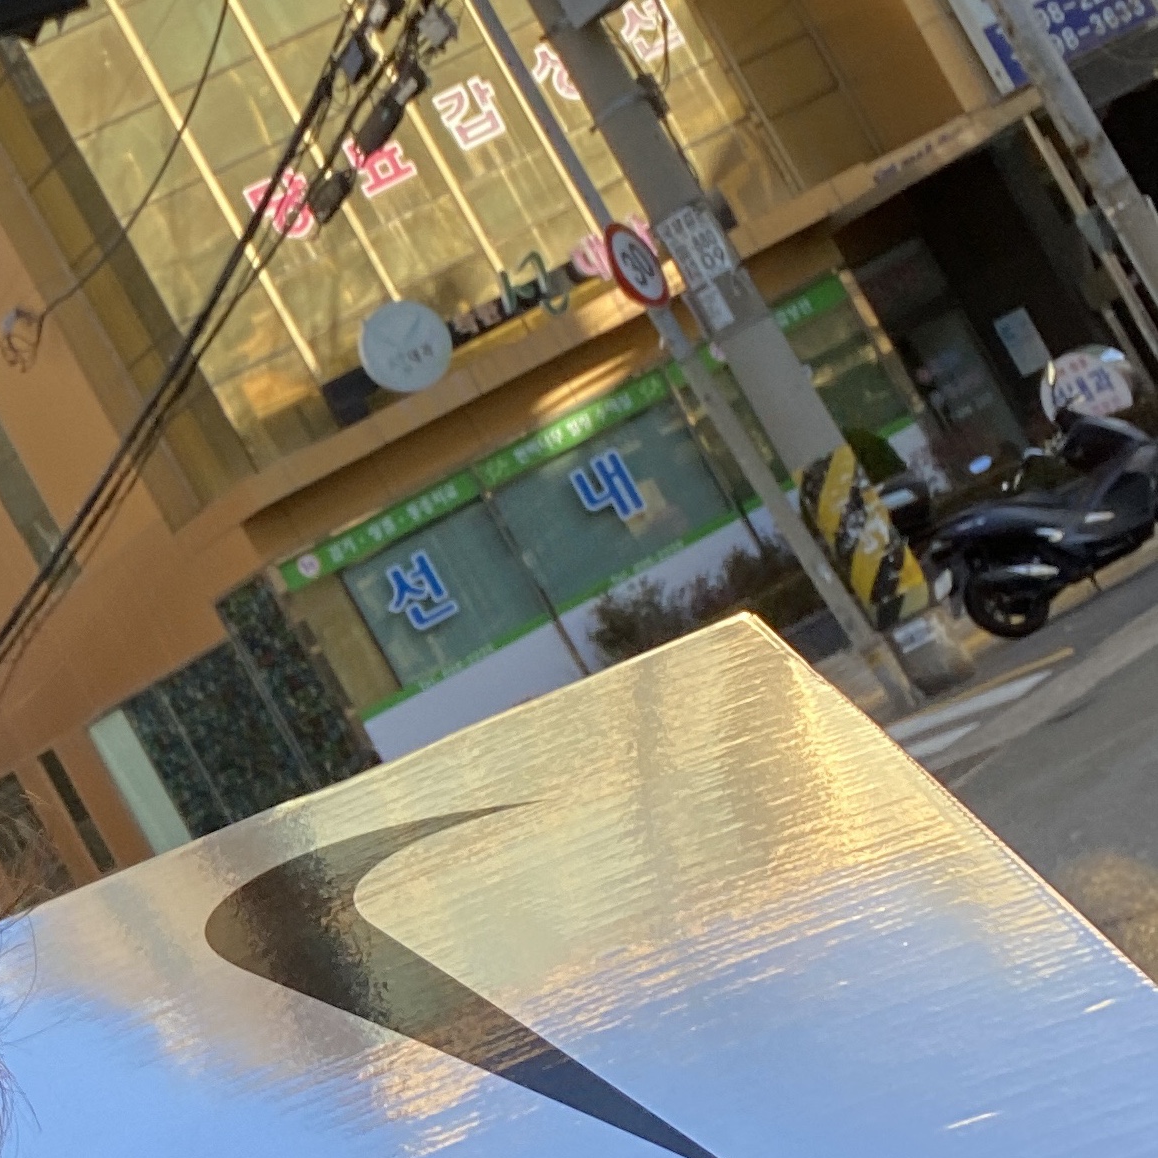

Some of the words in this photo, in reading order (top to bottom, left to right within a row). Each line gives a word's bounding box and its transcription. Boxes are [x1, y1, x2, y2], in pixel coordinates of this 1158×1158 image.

[621, 242, 656, 287] 30
[388, 549, 459, 632] 선
[569, 448, 645, 521] 내
